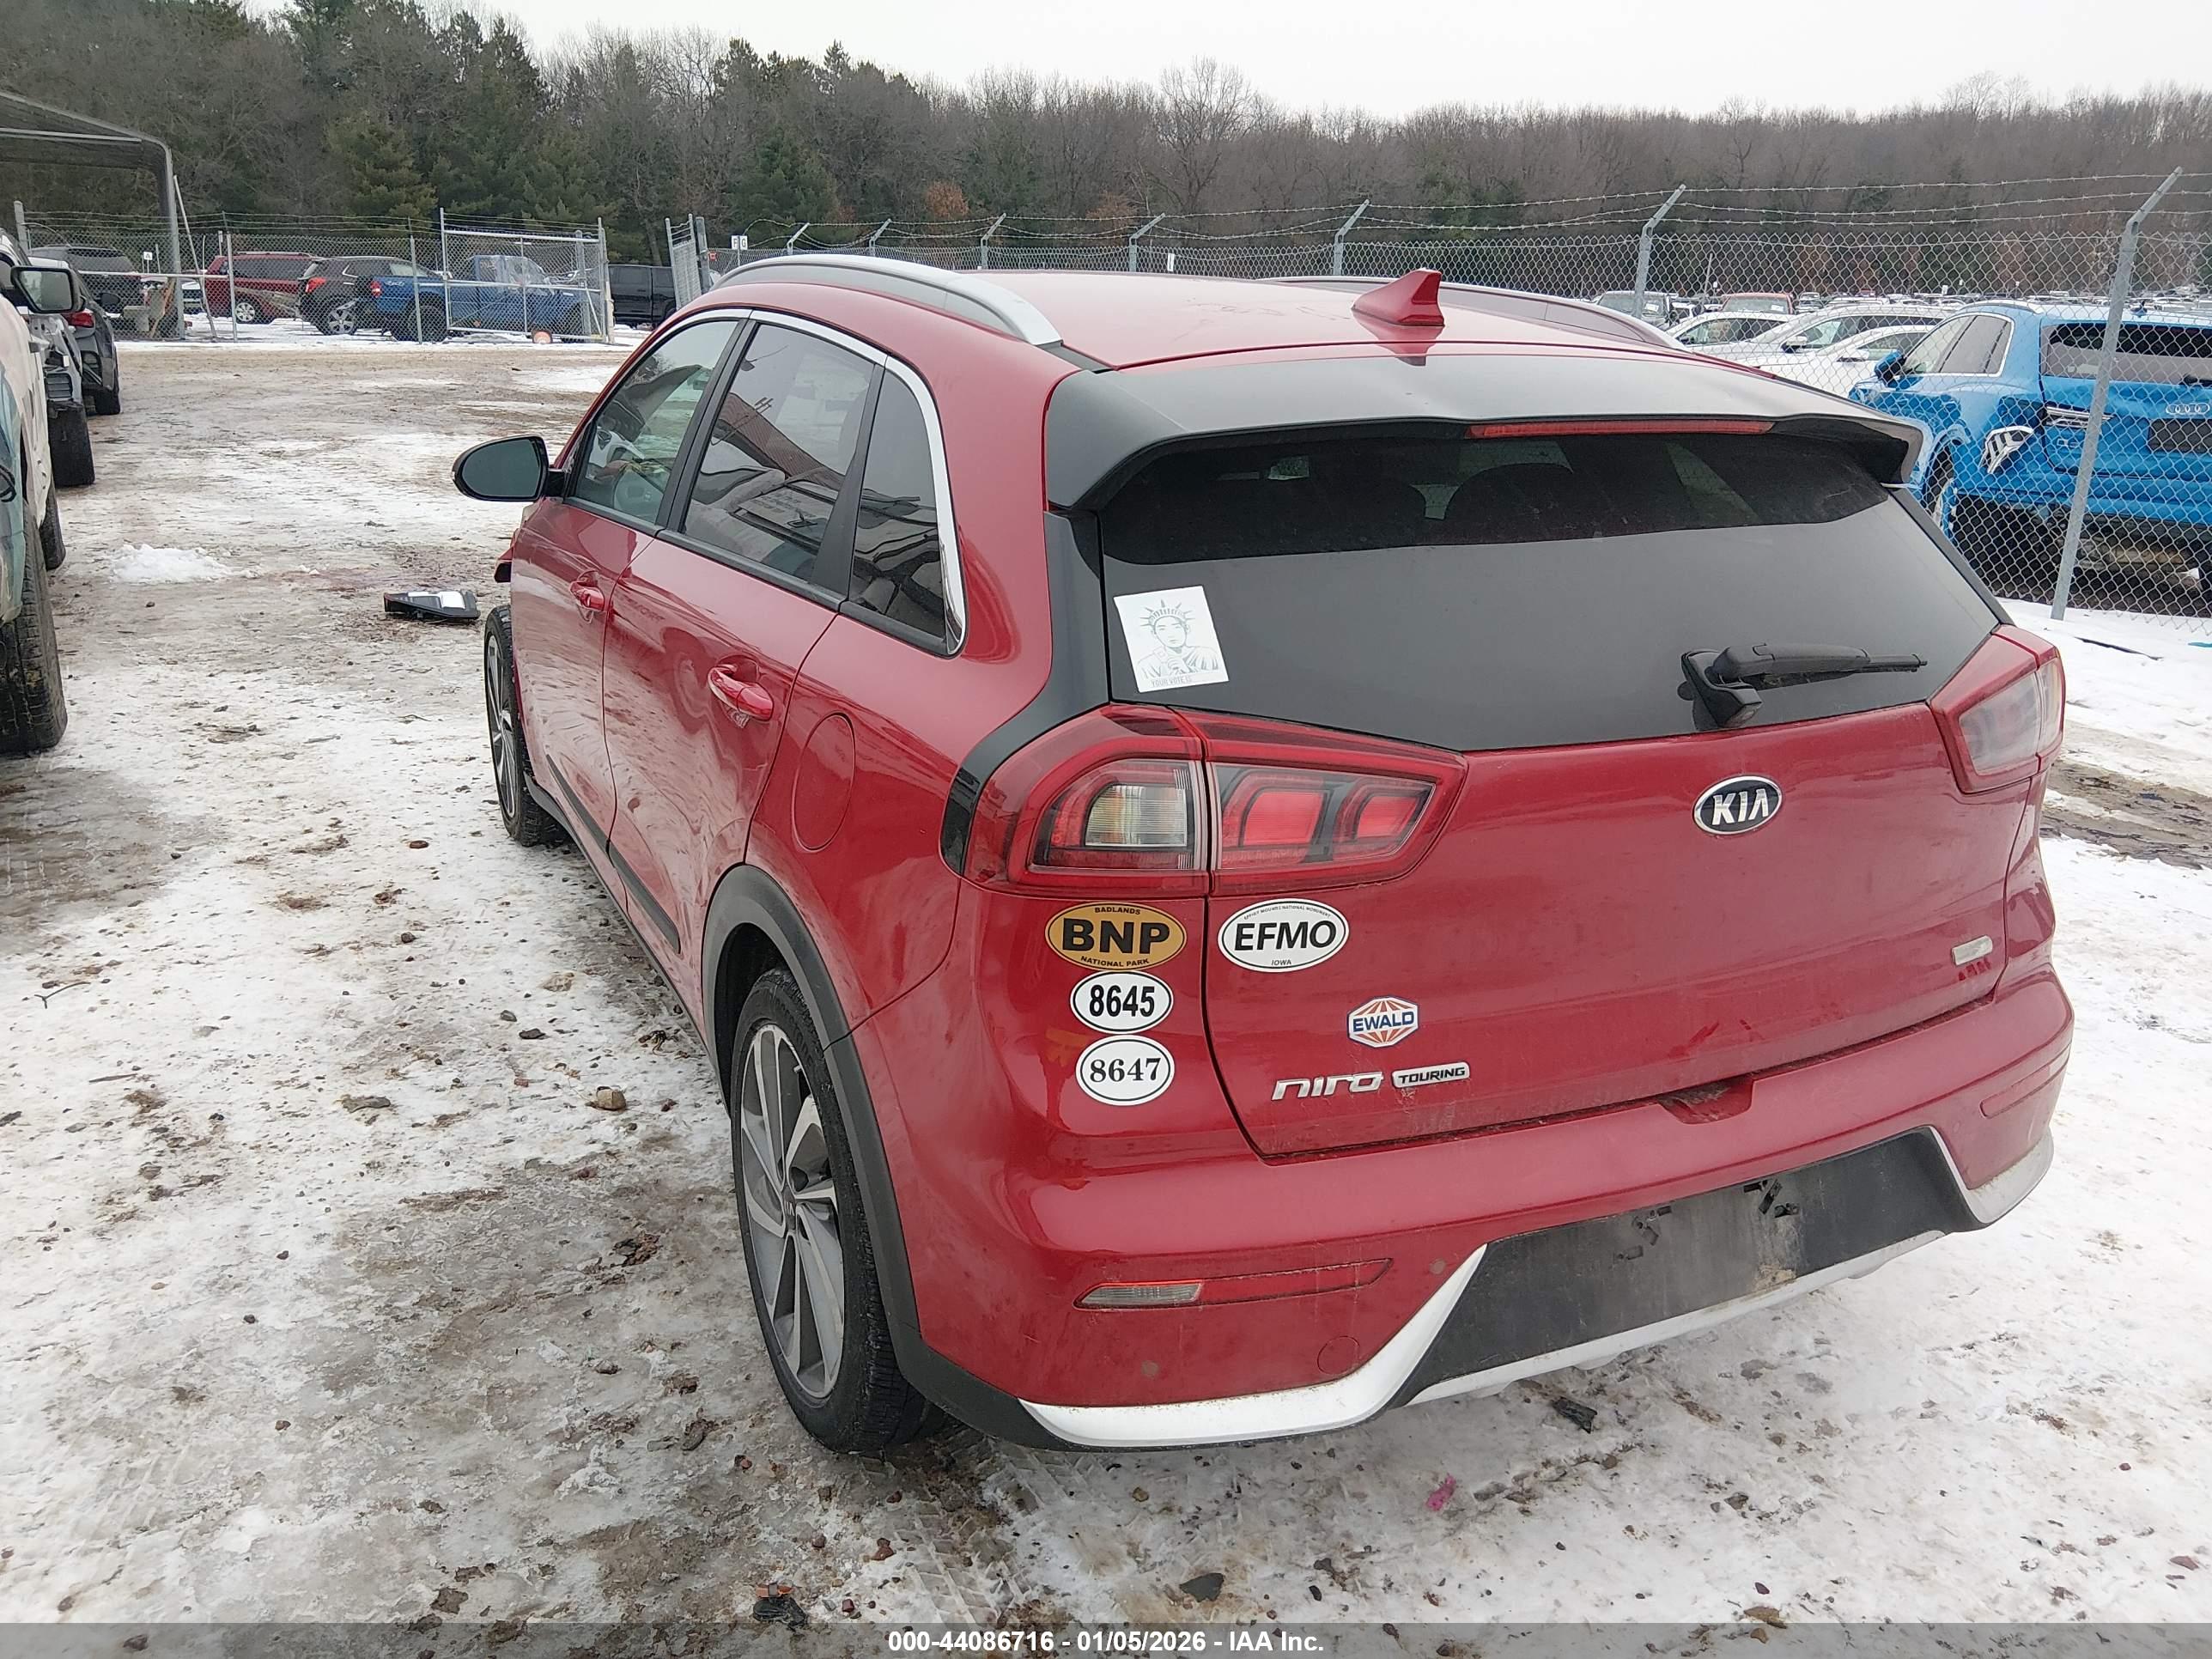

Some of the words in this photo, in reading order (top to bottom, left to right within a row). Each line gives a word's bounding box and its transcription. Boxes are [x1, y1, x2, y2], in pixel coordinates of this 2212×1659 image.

[1711, 788, 1769, 825] KIA
[1094, 906, 1141, 915] BADLANDS
[1062, 917, 1170, 955] BNP
[1234, 920, 1337, 951] EFMO
[1080, 955, 1124, 967] NATIONAL
[1126, 957, 1150, 967] PARK
[1089, 984, 1155, 1018] 8645
[1352, 1011, 1414, 1032] EWALD
[1090, 1057, 1161, 1082] 8647
[1398, 1066, 1466, 1084] TOURING
